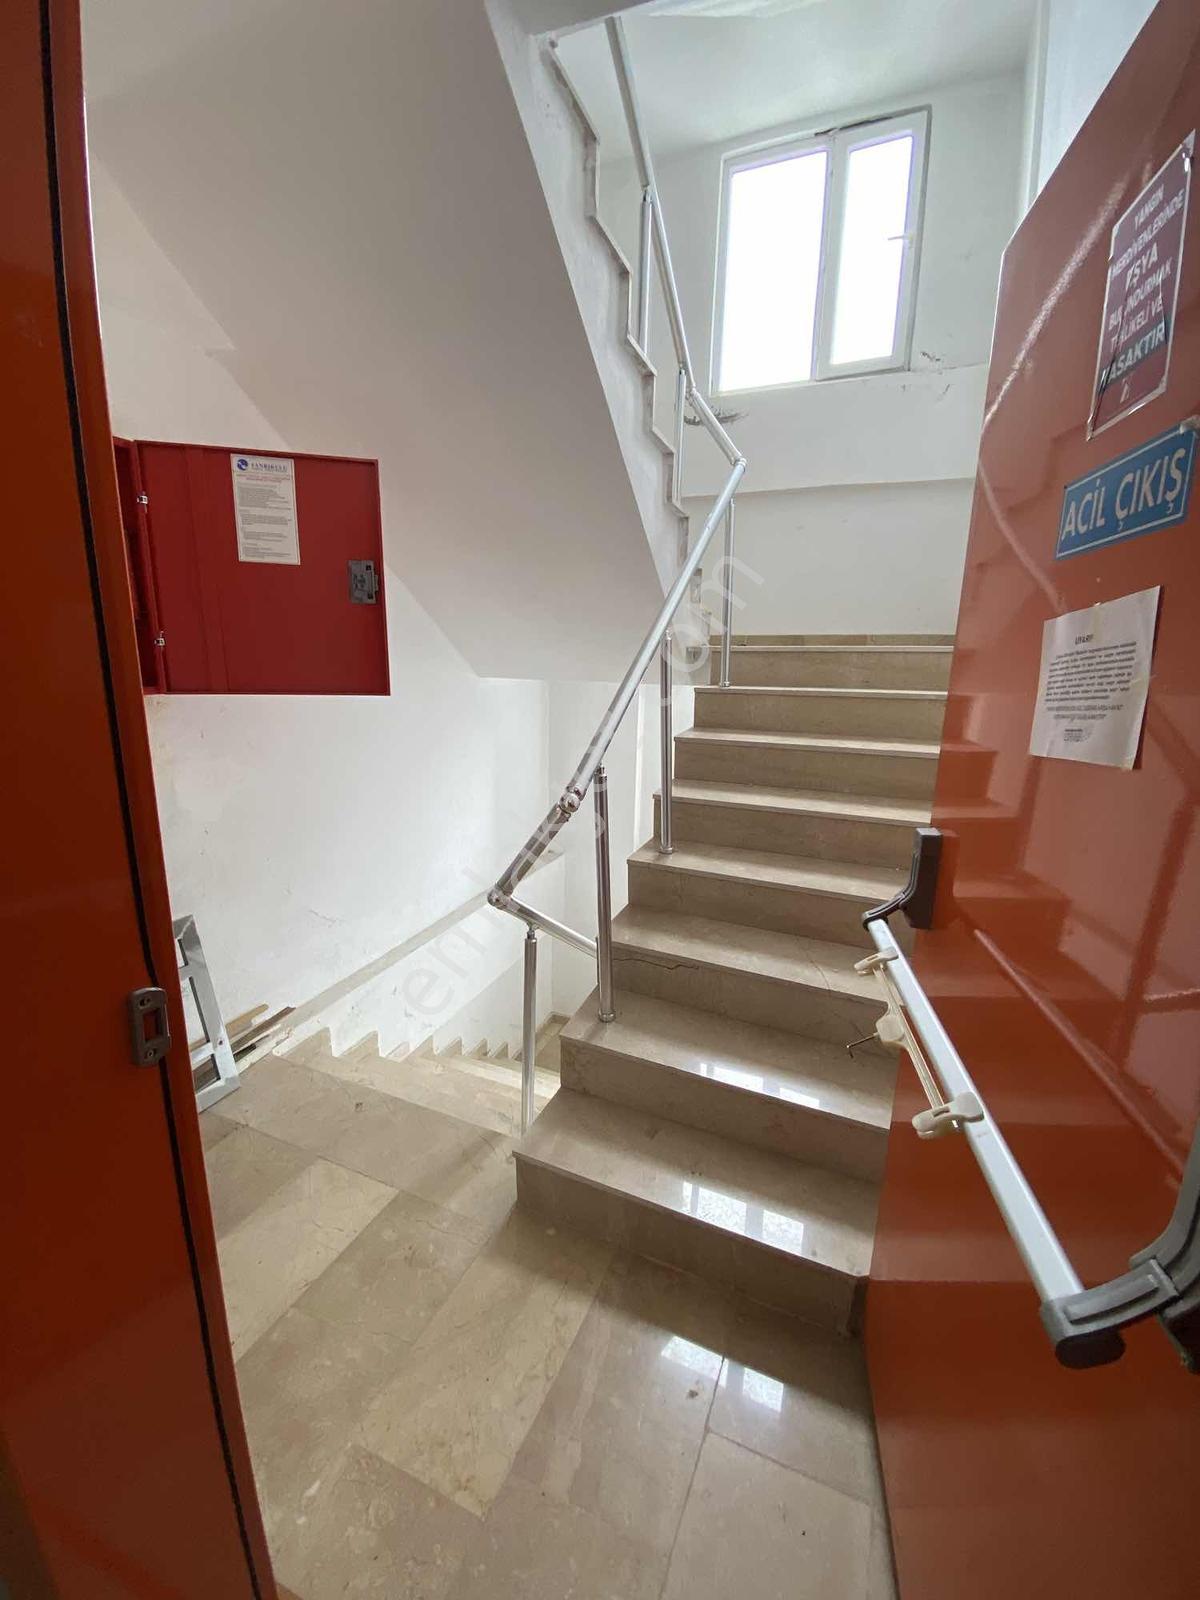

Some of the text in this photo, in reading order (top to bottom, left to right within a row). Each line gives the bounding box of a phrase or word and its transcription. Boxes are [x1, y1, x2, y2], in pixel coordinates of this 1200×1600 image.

[1108, 258, 1172, 331] BULNDURMAK
[1061, 447, 1186, 540] ACİL ÇIKIŞ
